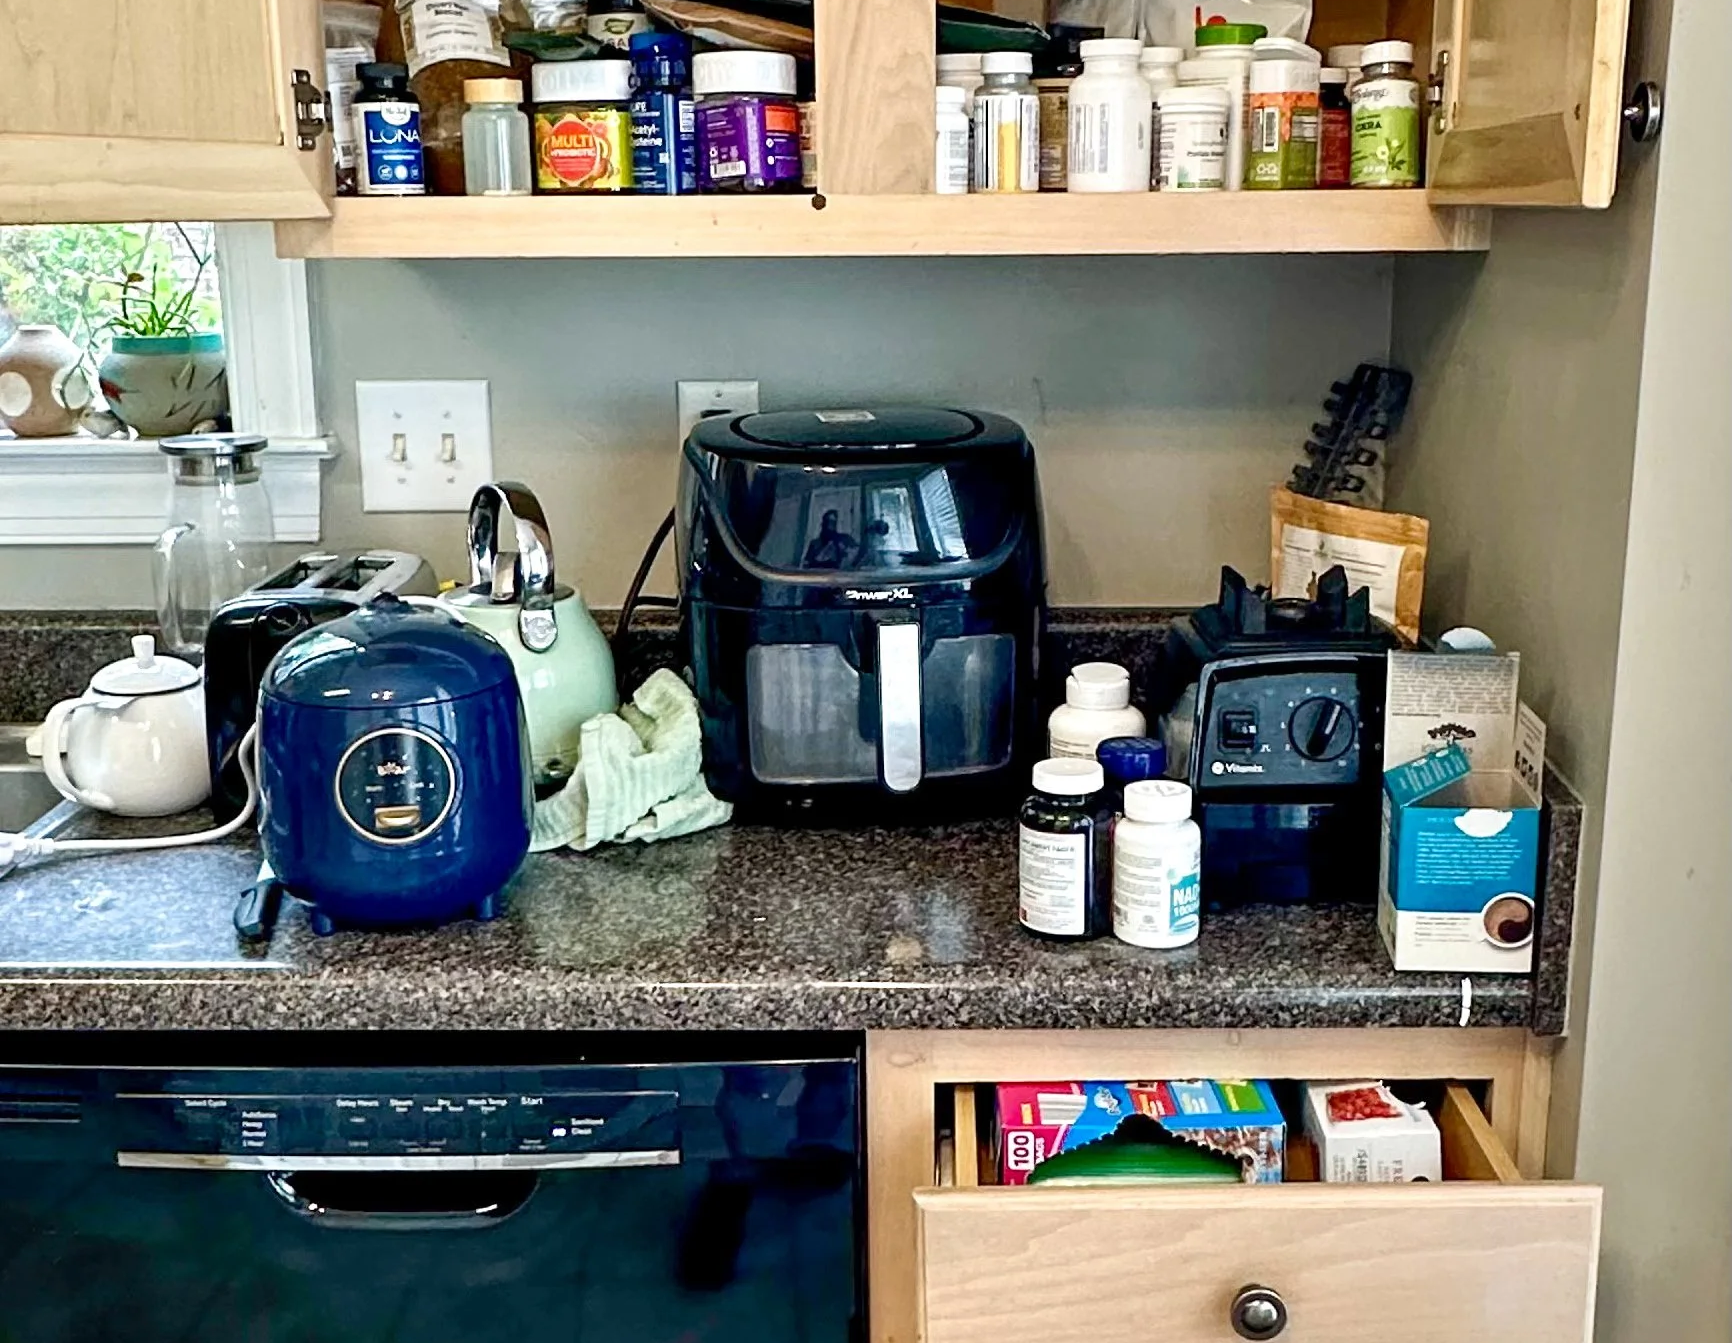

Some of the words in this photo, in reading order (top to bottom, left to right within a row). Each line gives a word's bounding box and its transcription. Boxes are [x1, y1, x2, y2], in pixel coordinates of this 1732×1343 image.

[369, 128, 421, 145] LUNA
[551, 135, 594, 149] MULTI
[1013, 1135, 1030, 1167] 100
